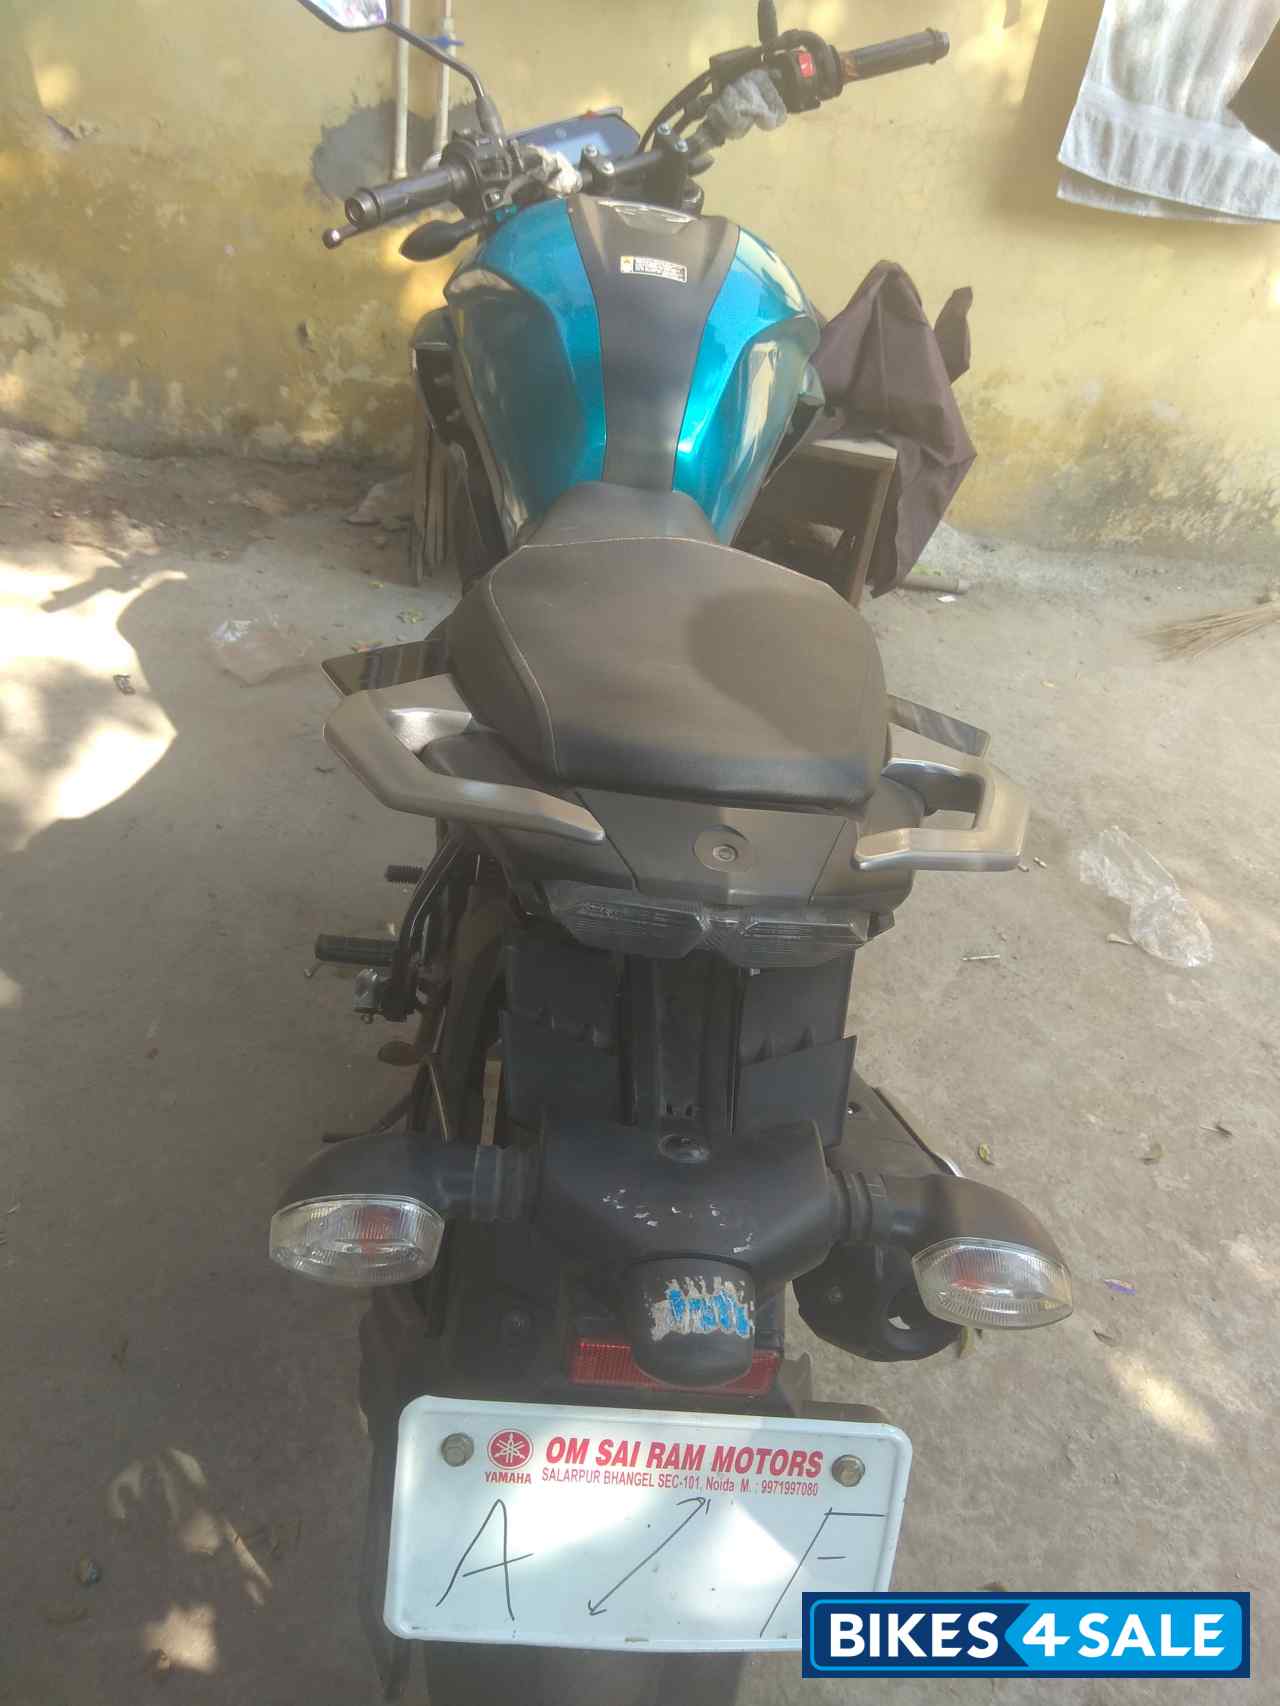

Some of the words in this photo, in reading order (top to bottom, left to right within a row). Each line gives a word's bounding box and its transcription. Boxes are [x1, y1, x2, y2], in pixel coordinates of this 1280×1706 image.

[546, 1436, 591, 1465] OM
[595, 1438, 642, 1468] SAI
[645, 1441, 707, 1471] RAM
[711, 1445, 824, 1478] MOTORS
[484, 1471, 532, 1485] YAMAHA
[542, 1467, 600, 1484] SALARPUR
[603, 1470, 655, 1488] BHANGEL
[705, 1476, 736, 1492] Noida
